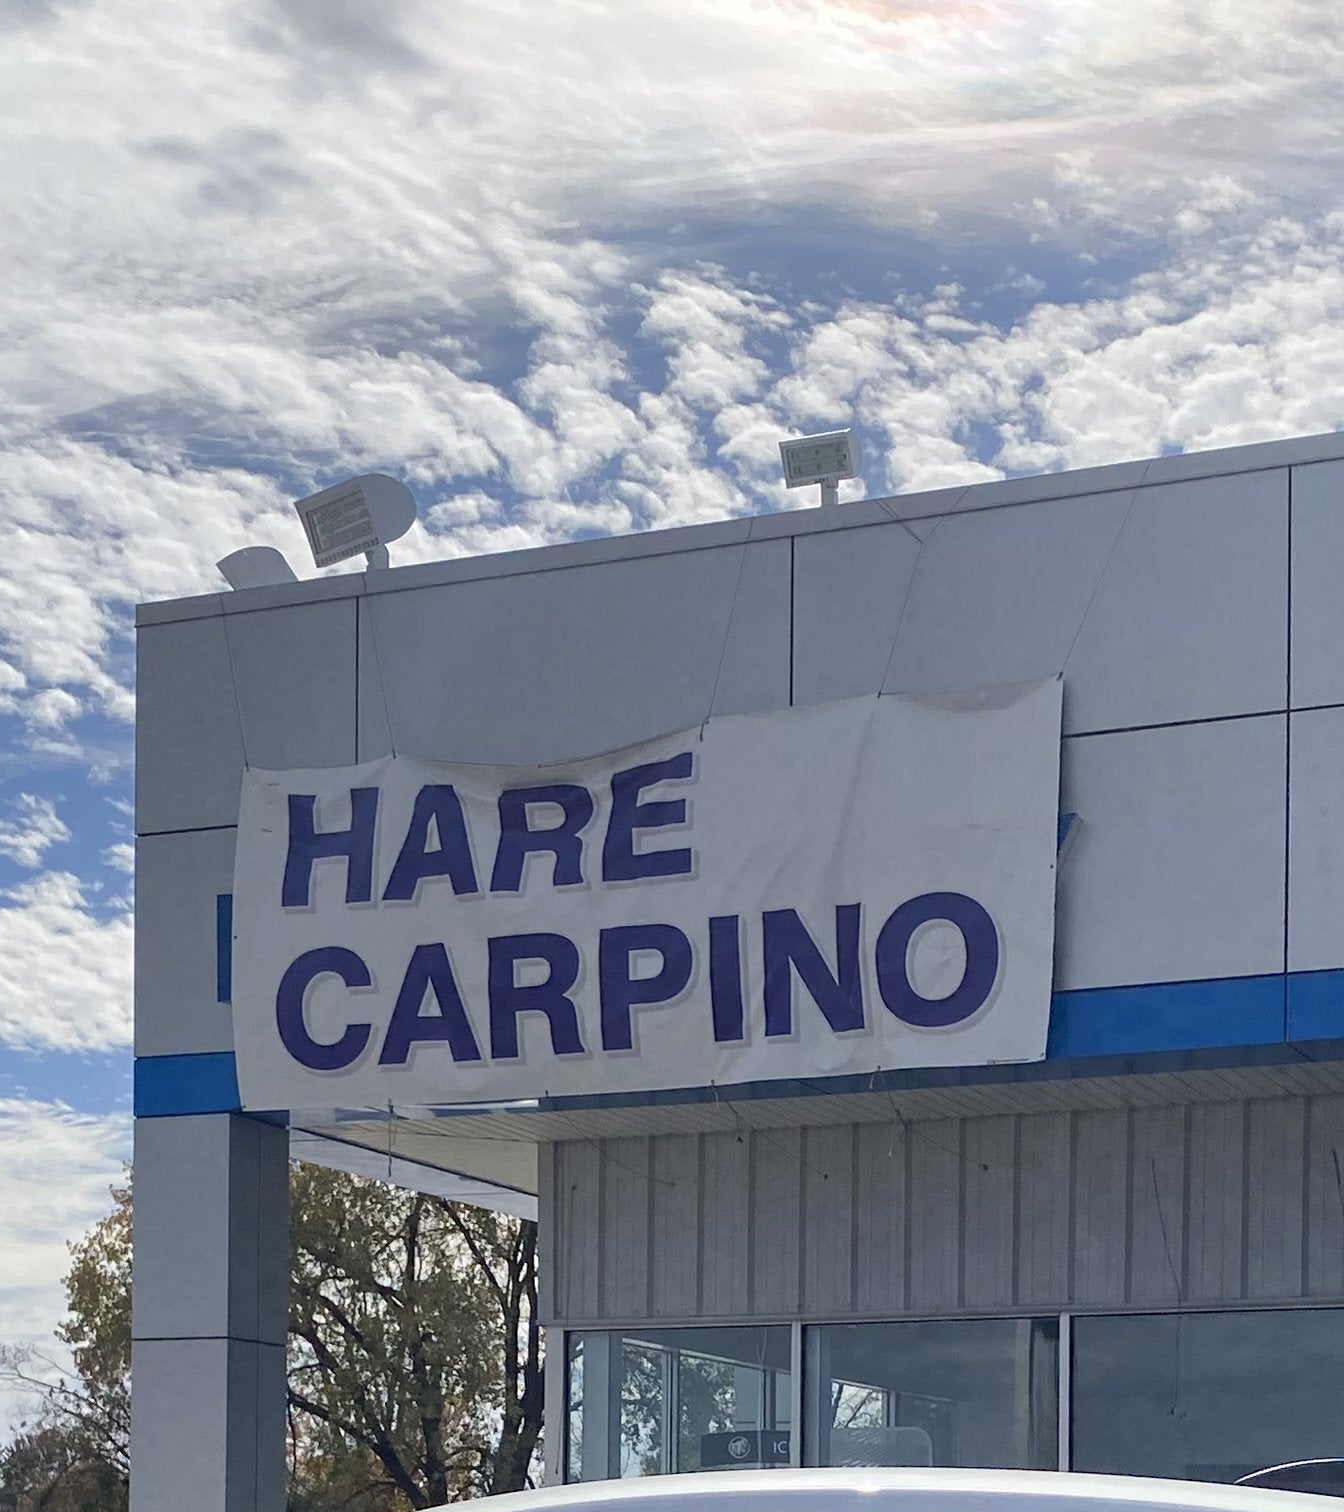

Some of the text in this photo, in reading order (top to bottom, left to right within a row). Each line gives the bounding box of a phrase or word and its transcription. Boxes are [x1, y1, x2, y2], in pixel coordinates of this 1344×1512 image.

[281, 751, 695, 907] HARE
[275, 891, 1001, 1071] CARPINO
[773, 1440, 790, 1454] IC
